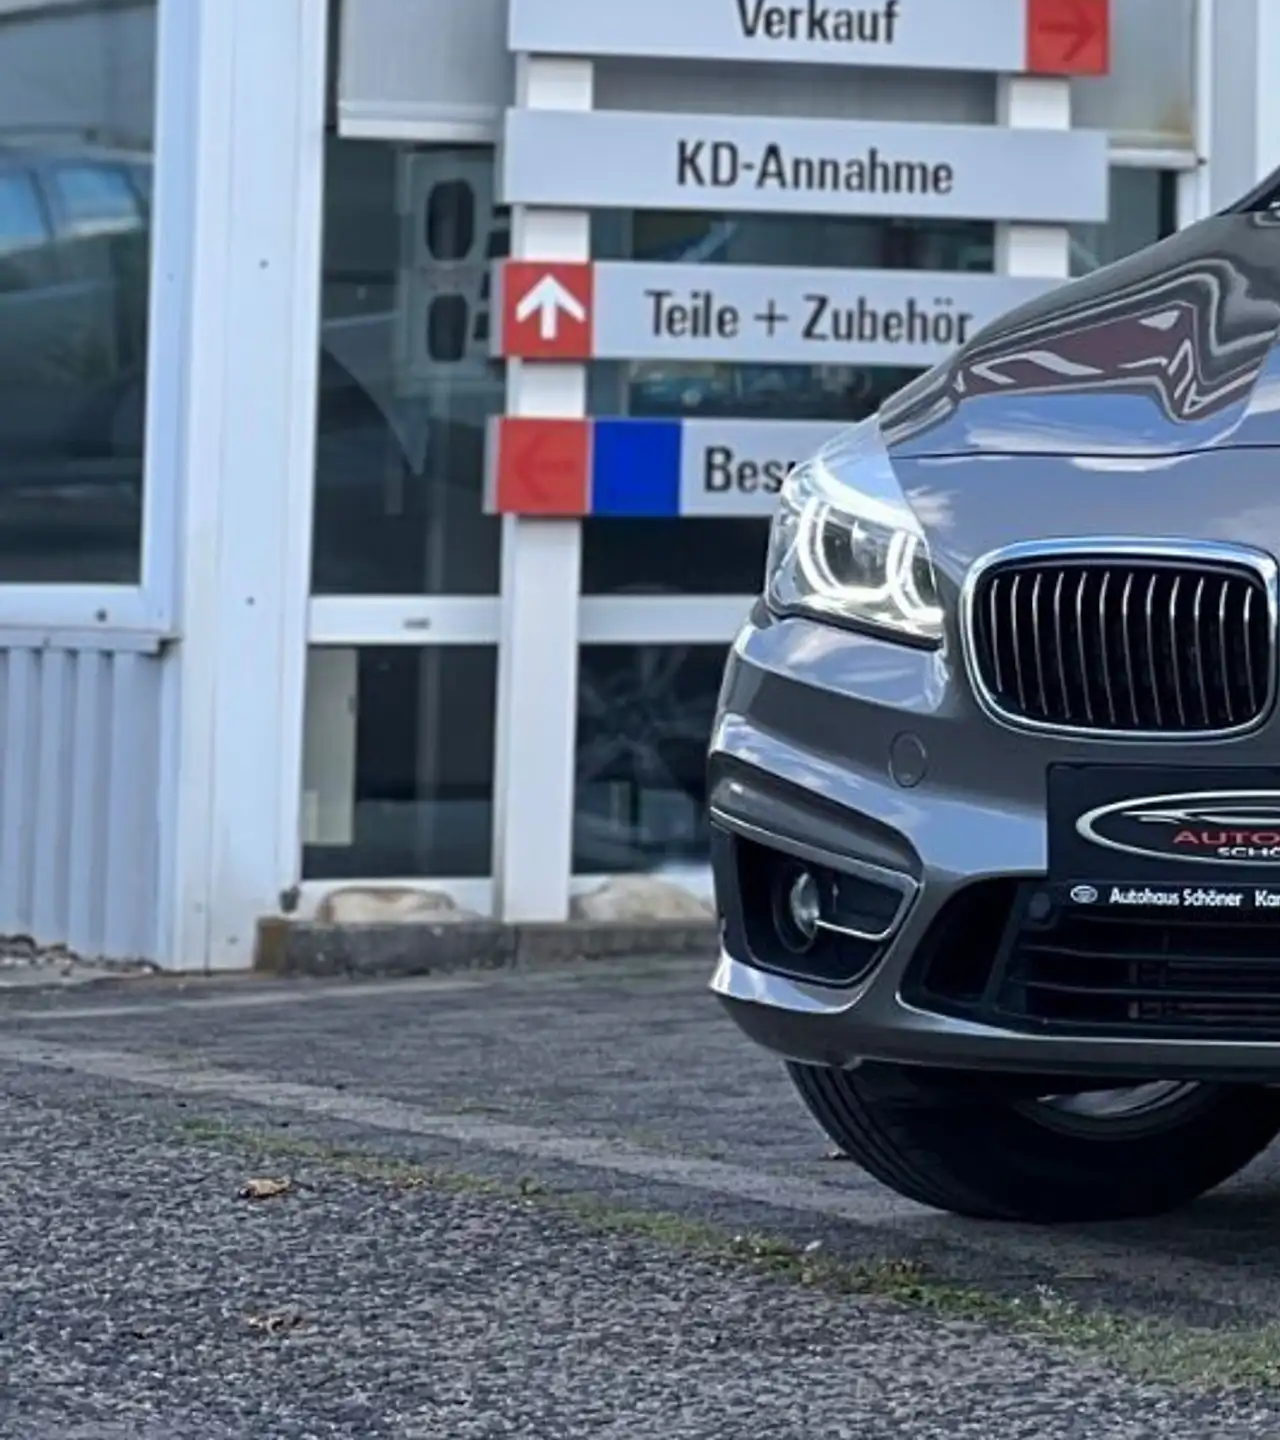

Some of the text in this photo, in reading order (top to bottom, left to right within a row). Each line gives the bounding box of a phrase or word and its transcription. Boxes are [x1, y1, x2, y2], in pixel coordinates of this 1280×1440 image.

[676, 139, 954, 196] KD-Annahme
[645, 289, 740, 339] Teile
[801, 296, 974, 346] Zubehör
[1109, 886, 1180, 906] Autohaus
[1182, 887, 1244, 907] Schöner
